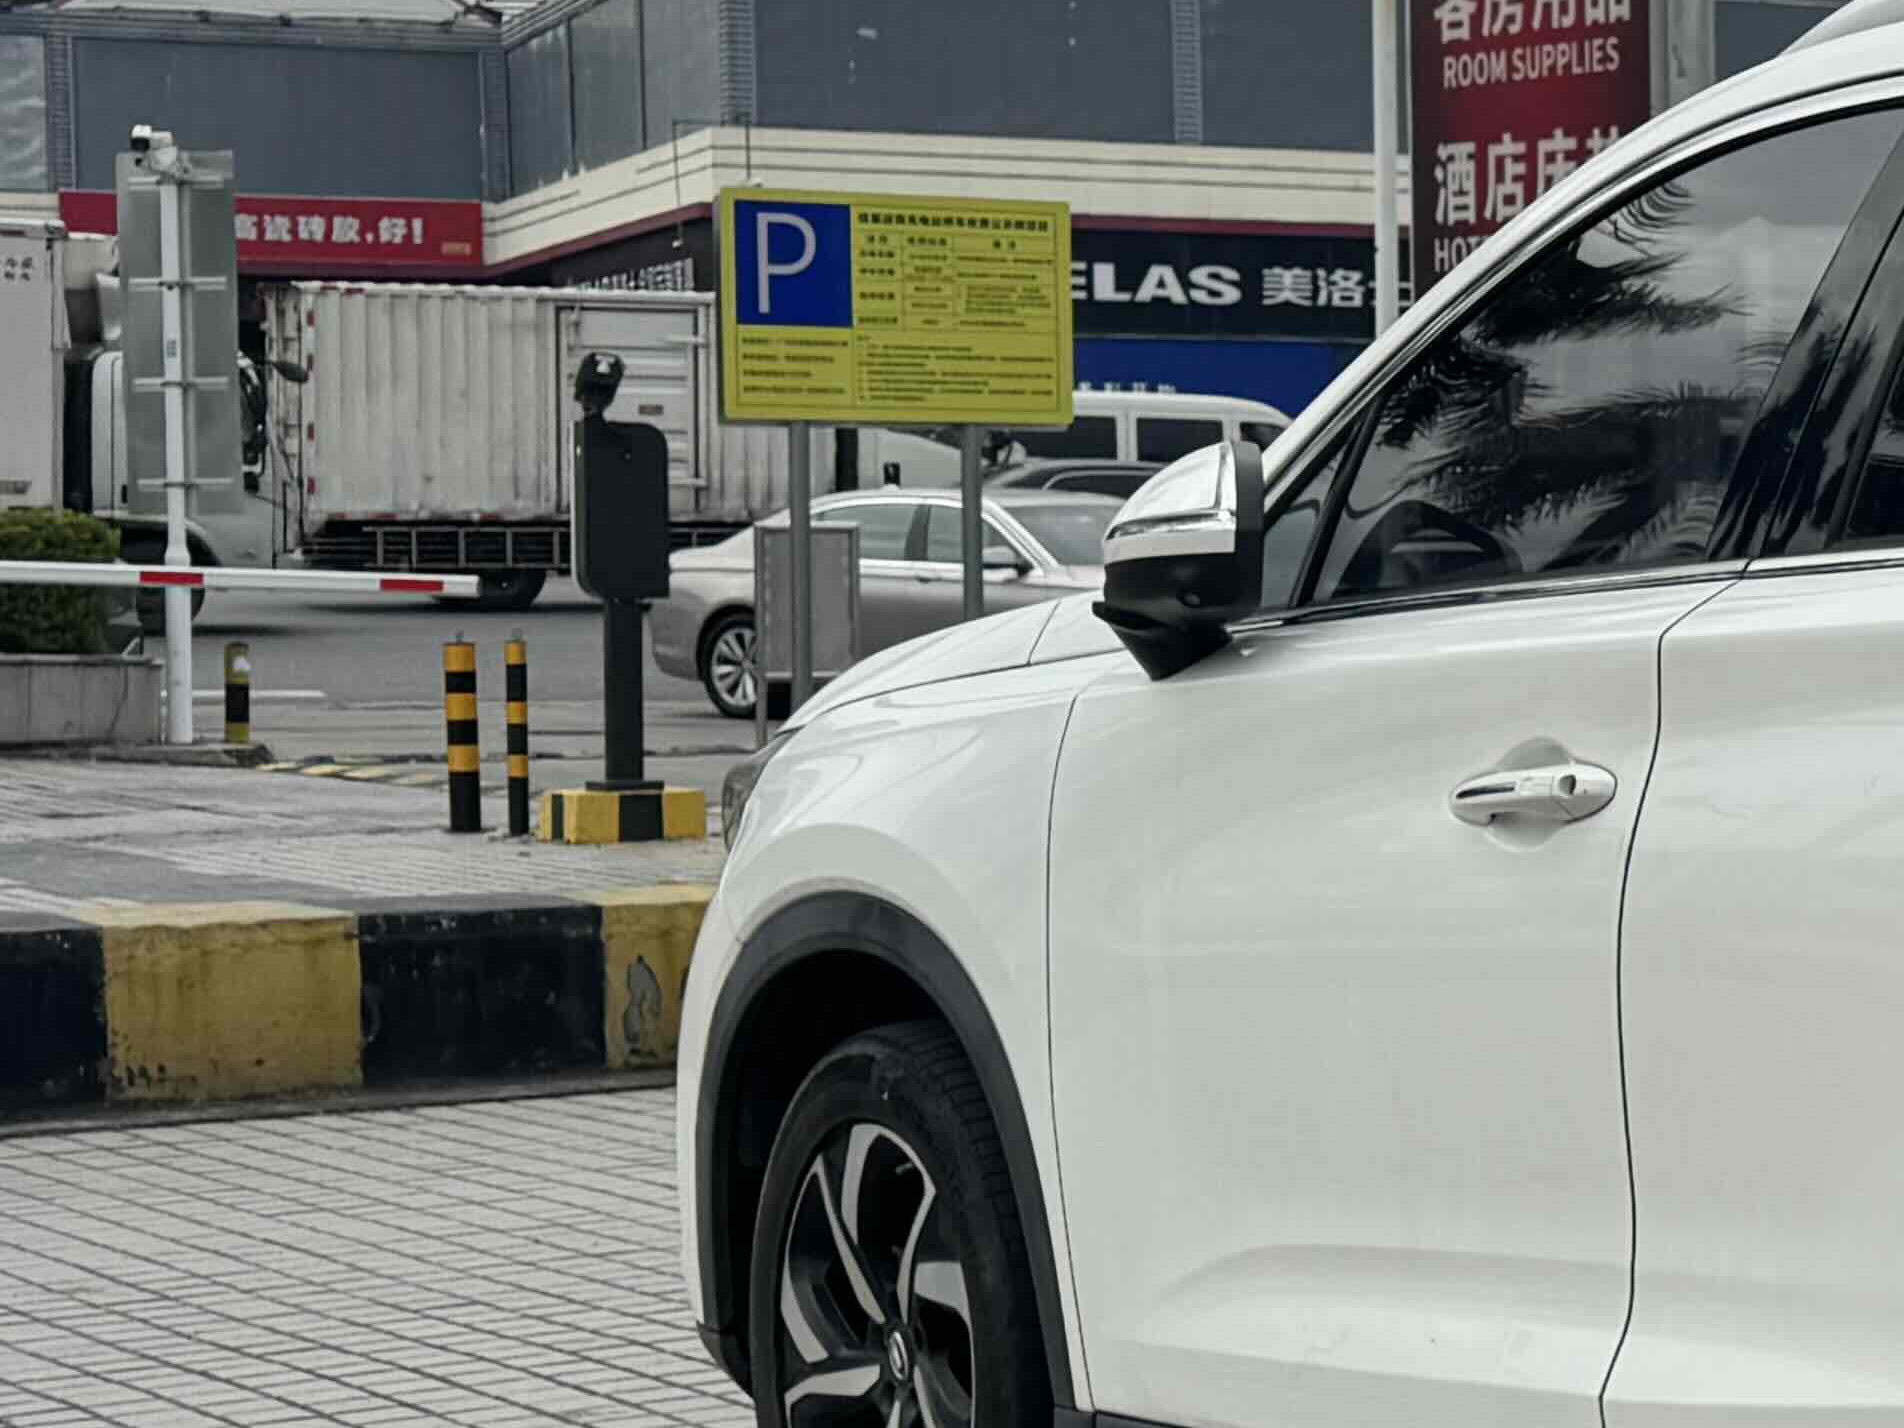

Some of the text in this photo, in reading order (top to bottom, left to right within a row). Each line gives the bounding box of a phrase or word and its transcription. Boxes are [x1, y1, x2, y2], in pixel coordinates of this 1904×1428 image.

[1443, 37, 1621, 90] ROOM SUPPLIES
[756, 211, 817, 314] P
